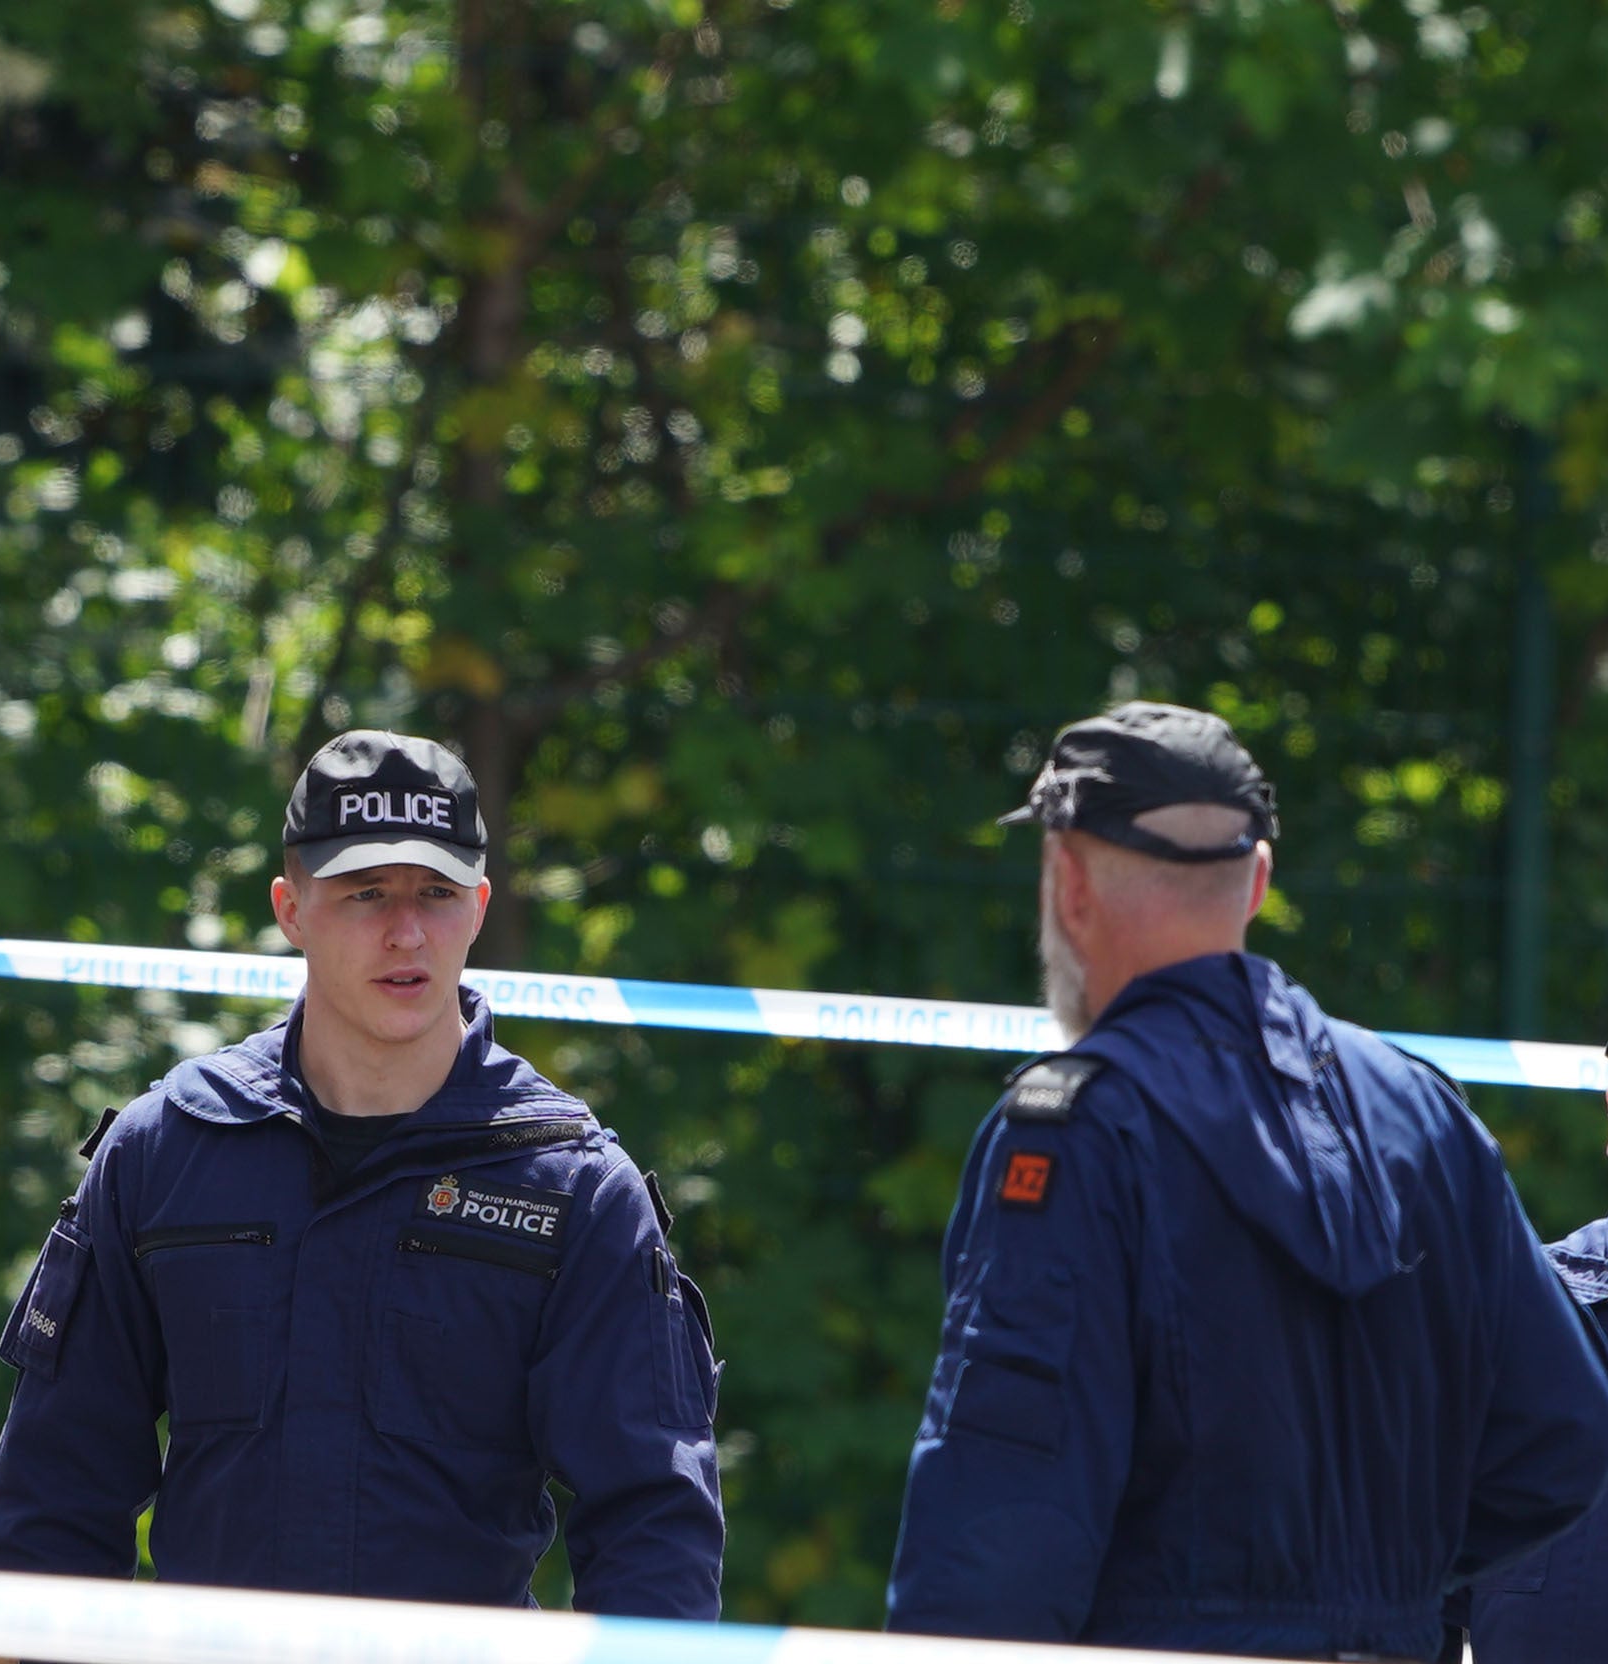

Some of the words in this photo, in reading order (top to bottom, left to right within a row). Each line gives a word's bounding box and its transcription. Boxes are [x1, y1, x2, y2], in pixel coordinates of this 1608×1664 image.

[339, 791, 452, 829] POLICE
[818, 1003, 951, 1044] POLICE
[967, 1010, 1051, 1052] LINE
[461, 1200, 557, 1236] POLICE
[467, 1190, 505, 1205] GREATER
[505, 1197, 560, 1215] MANCHESTER
